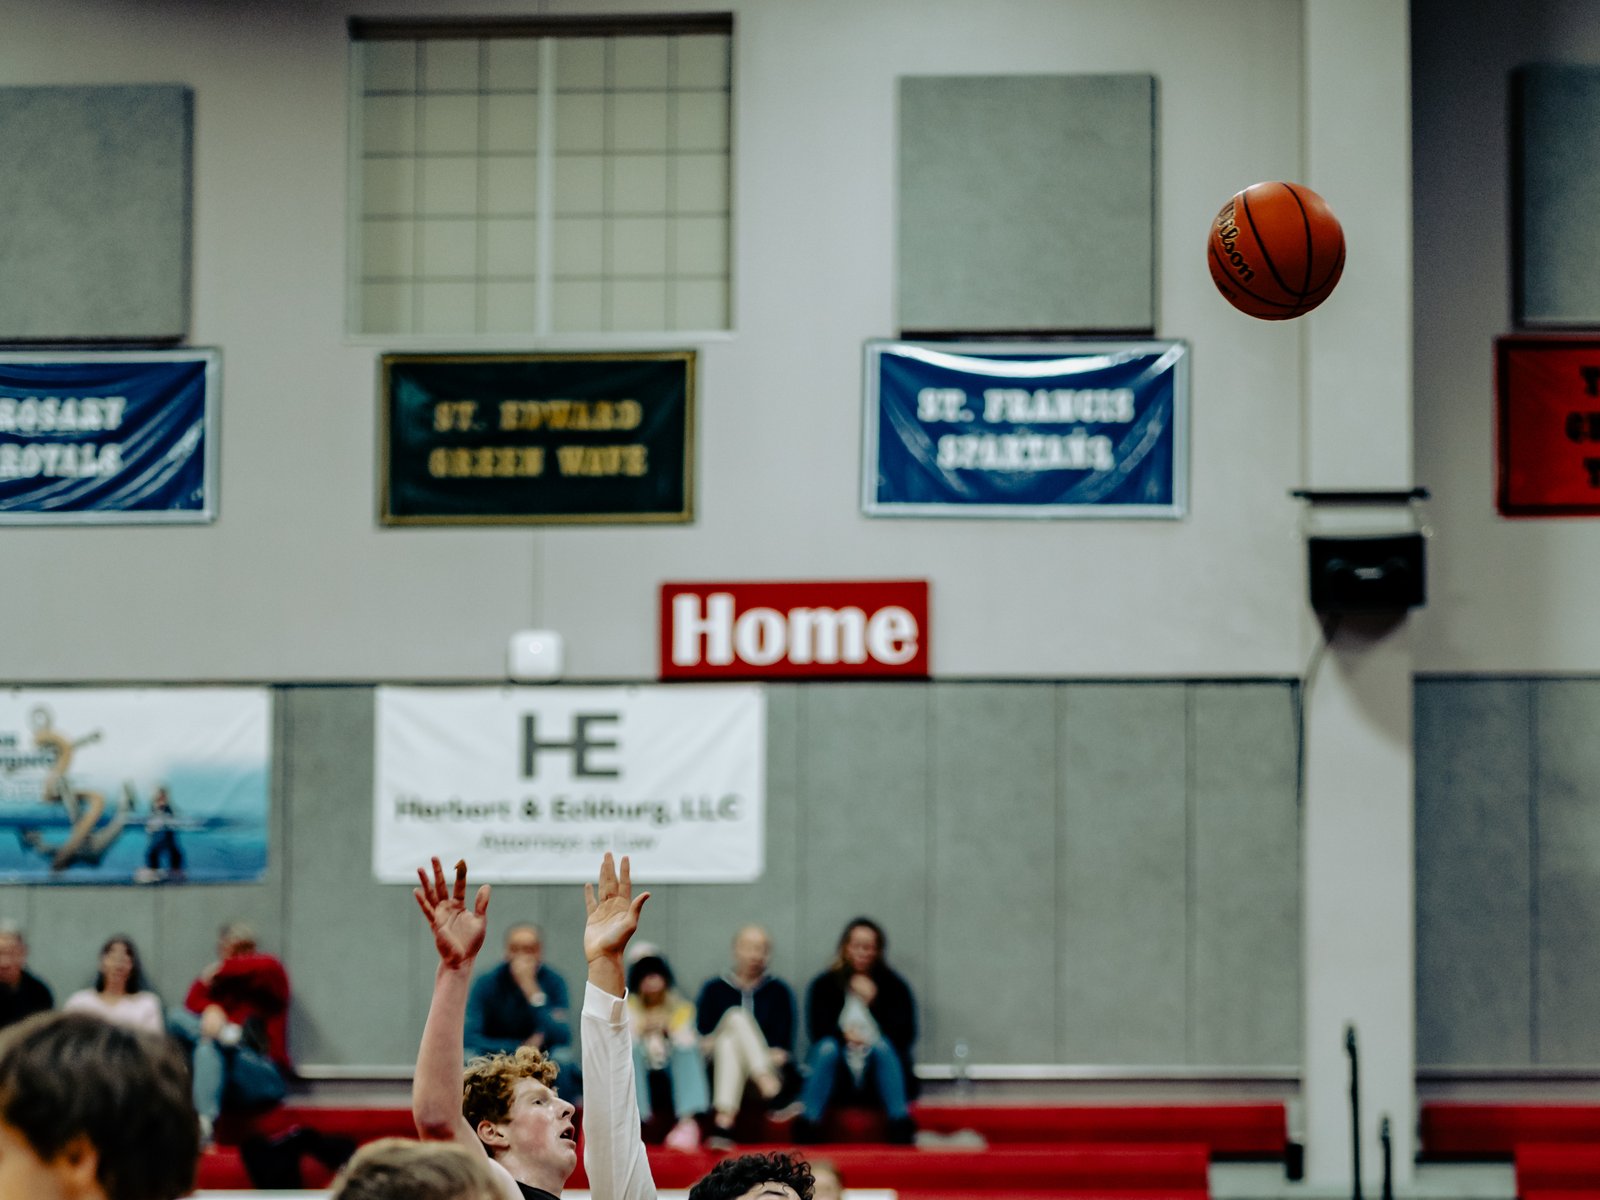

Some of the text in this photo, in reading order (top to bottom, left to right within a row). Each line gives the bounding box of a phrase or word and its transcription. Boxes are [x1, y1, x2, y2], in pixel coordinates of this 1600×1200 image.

[1217, 200, 1255, 282] Wilson
[917, 388, 1135, 423] ST. FRANCIS
[672, 592, 918, 666] Home
